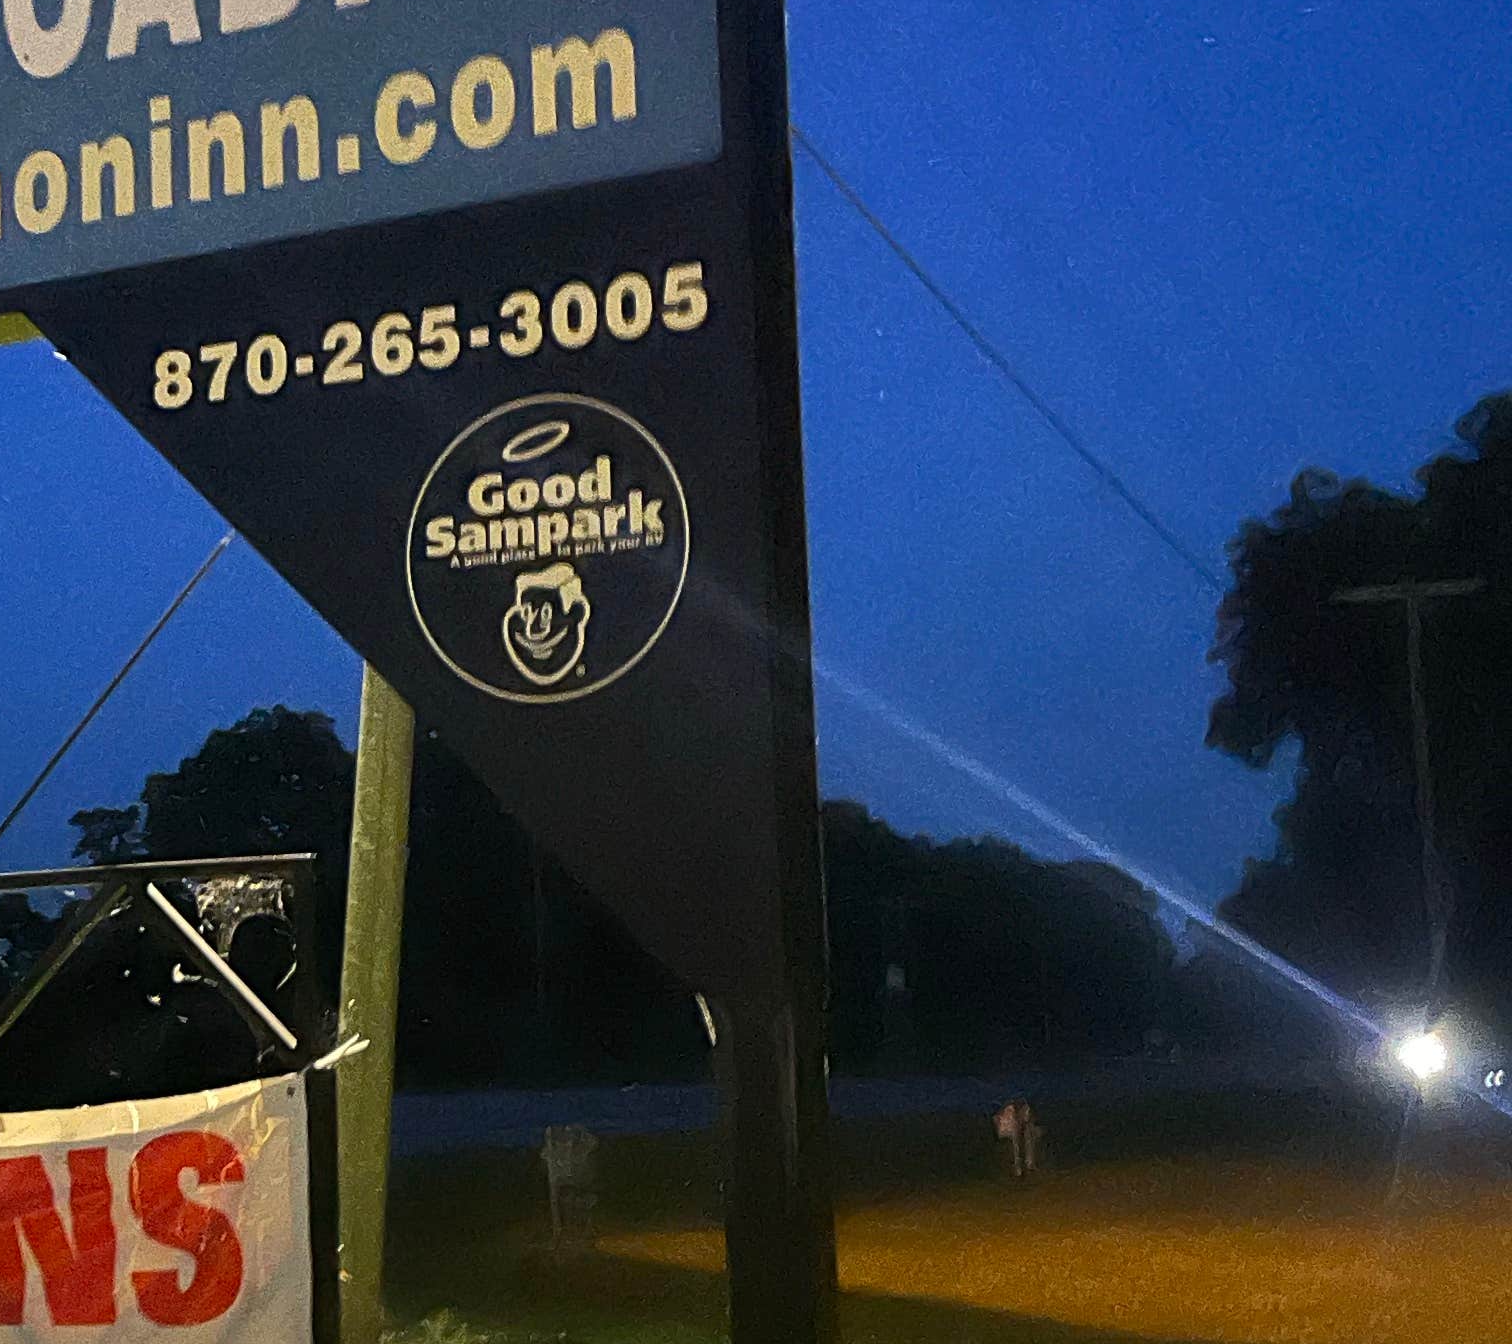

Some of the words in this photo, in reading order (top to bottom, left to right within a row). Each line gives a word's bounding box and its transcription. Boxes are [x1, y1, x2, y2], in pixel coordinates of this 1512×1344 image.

[153, 261, 709, 410] 870-265-3005
[467, 455, 613, 518] Good
[425, 488, 666, 558] Sampark
